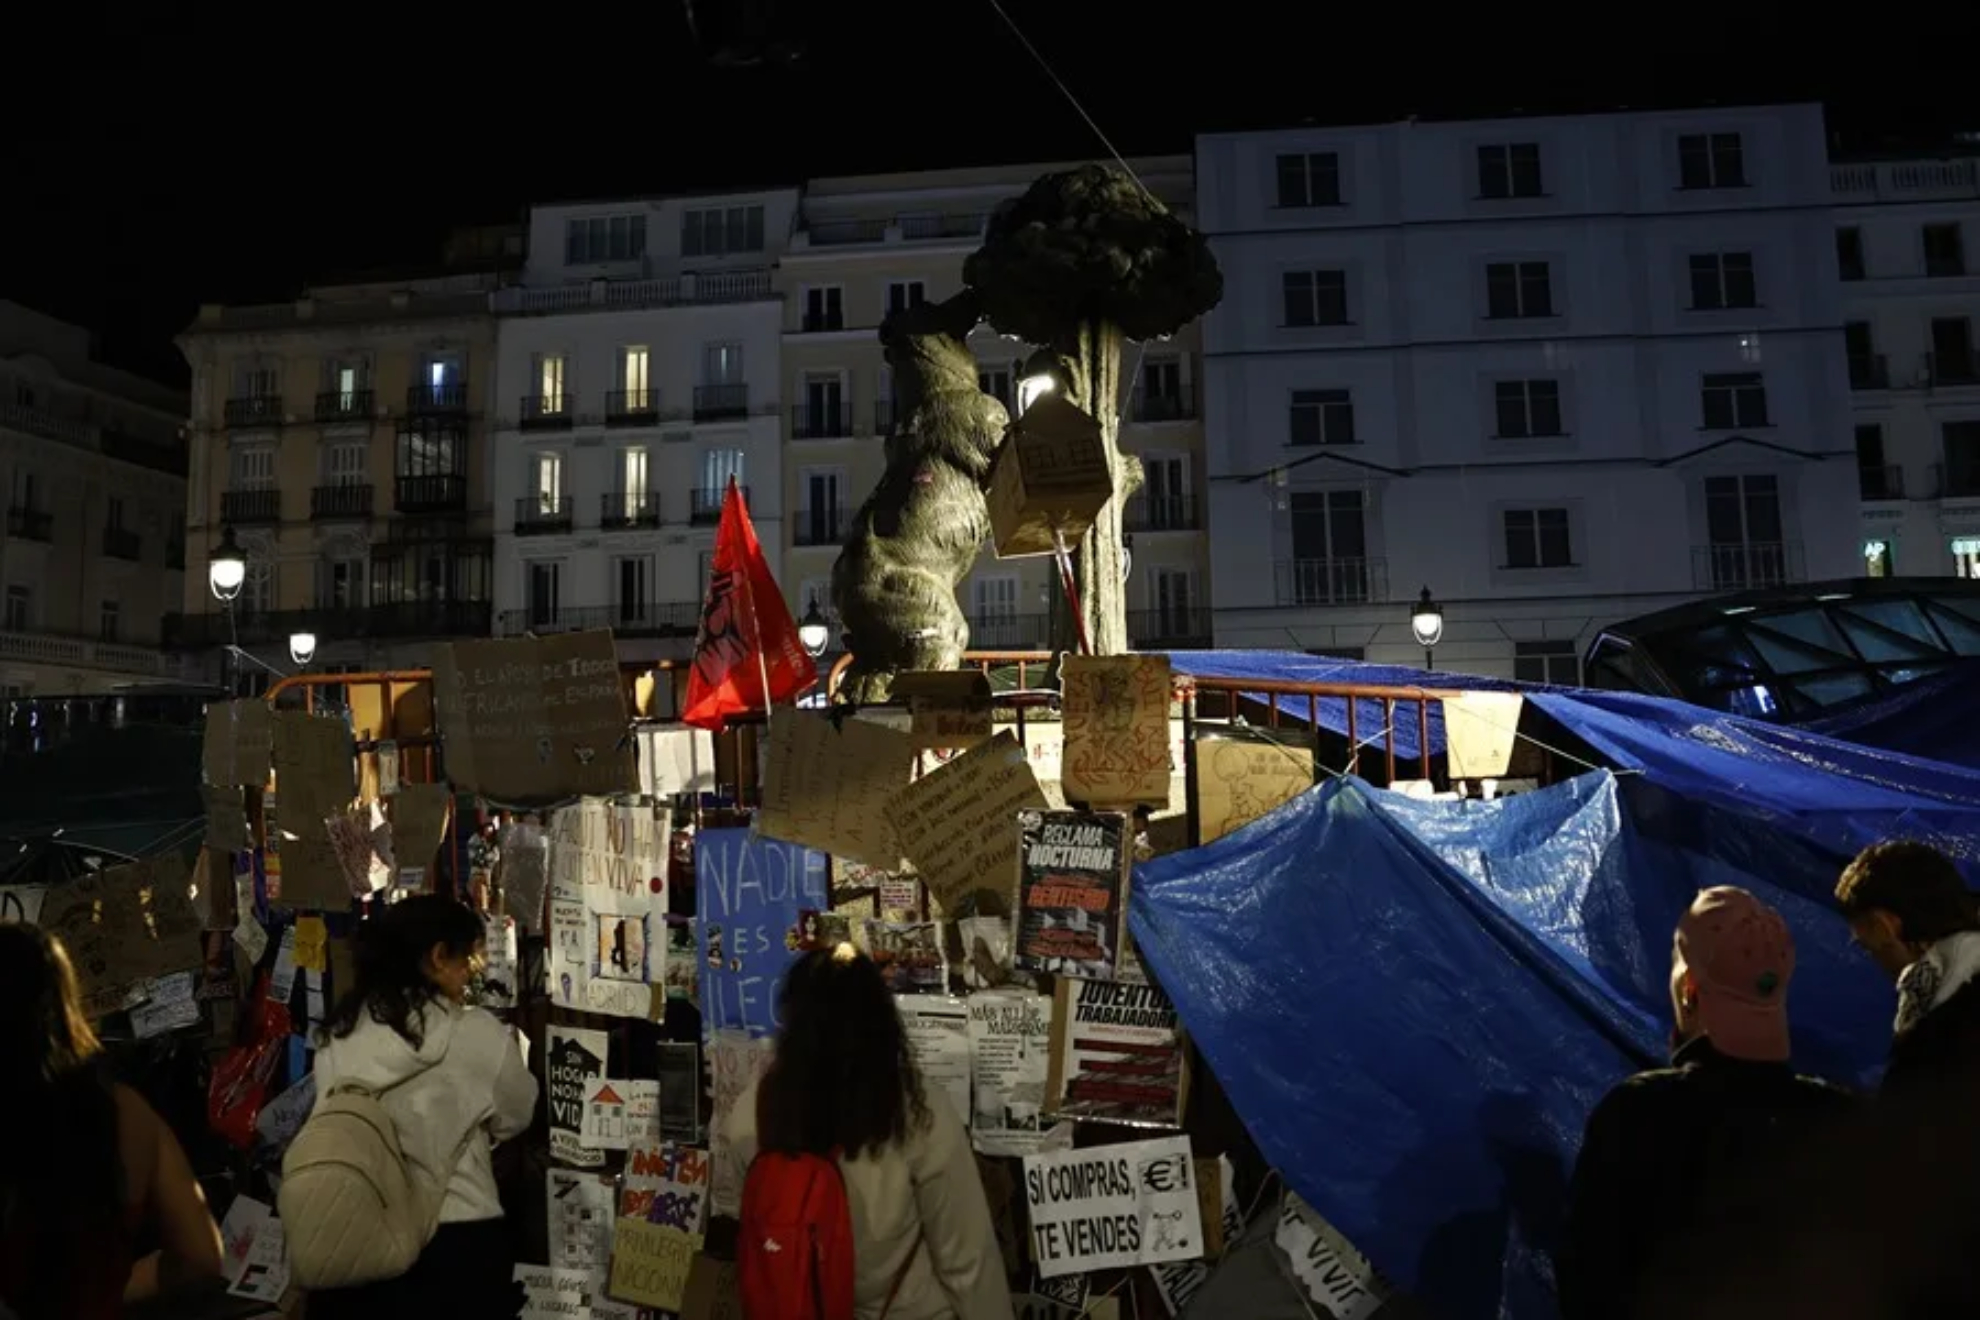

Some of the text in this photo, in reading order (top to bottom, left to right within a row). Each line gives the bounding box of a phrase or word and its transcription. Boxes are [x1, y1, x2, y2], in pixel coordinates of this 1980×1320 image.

[1041, 824, 1104, 847] RECLAMA
[1027, 843, 1115, 870] NOCTURNA
[701, 838, 827, 923] NADIE
[733, 925, 771, 953] ES
[1048, 1159, 1136, 1202] COMPRAS,
[1035, 1214, 1141, 1261] TE VENDES
